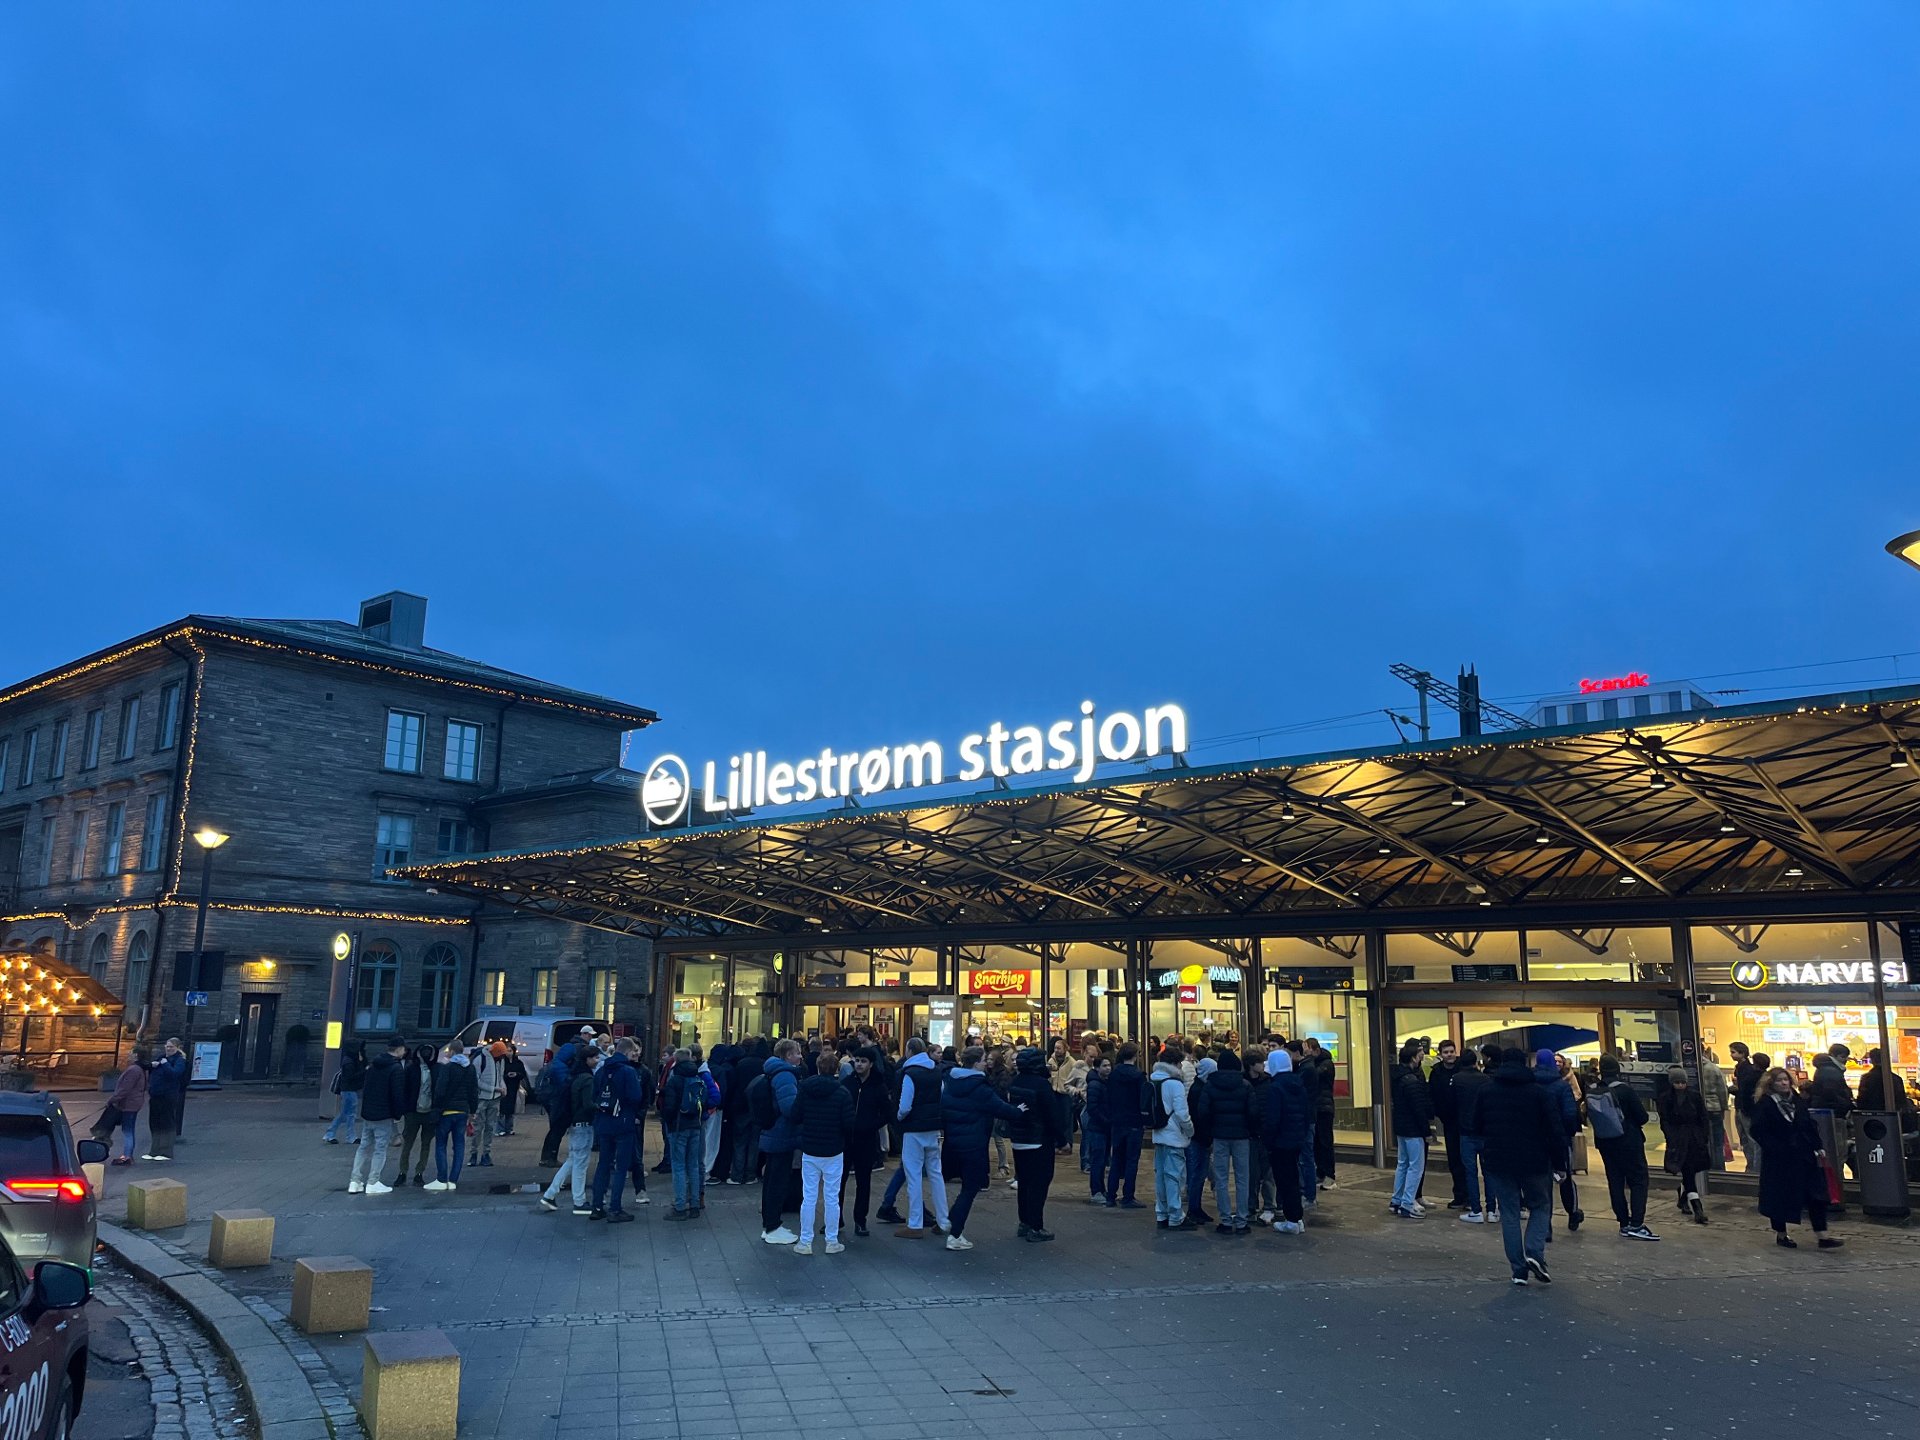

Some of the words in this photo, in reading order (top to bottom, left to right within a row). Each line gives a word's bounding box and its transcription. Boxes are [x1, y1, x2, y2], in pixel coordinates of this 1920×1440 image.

[1580, 672, 1649, 694] Scandic
[704, 741, 943, 812] Lillestrøm
[959, 700, 1187, 783] stasjon
[973, 970, 1026, 991] Snarkjøp
[0, 1361, 49, 1440] 2000
